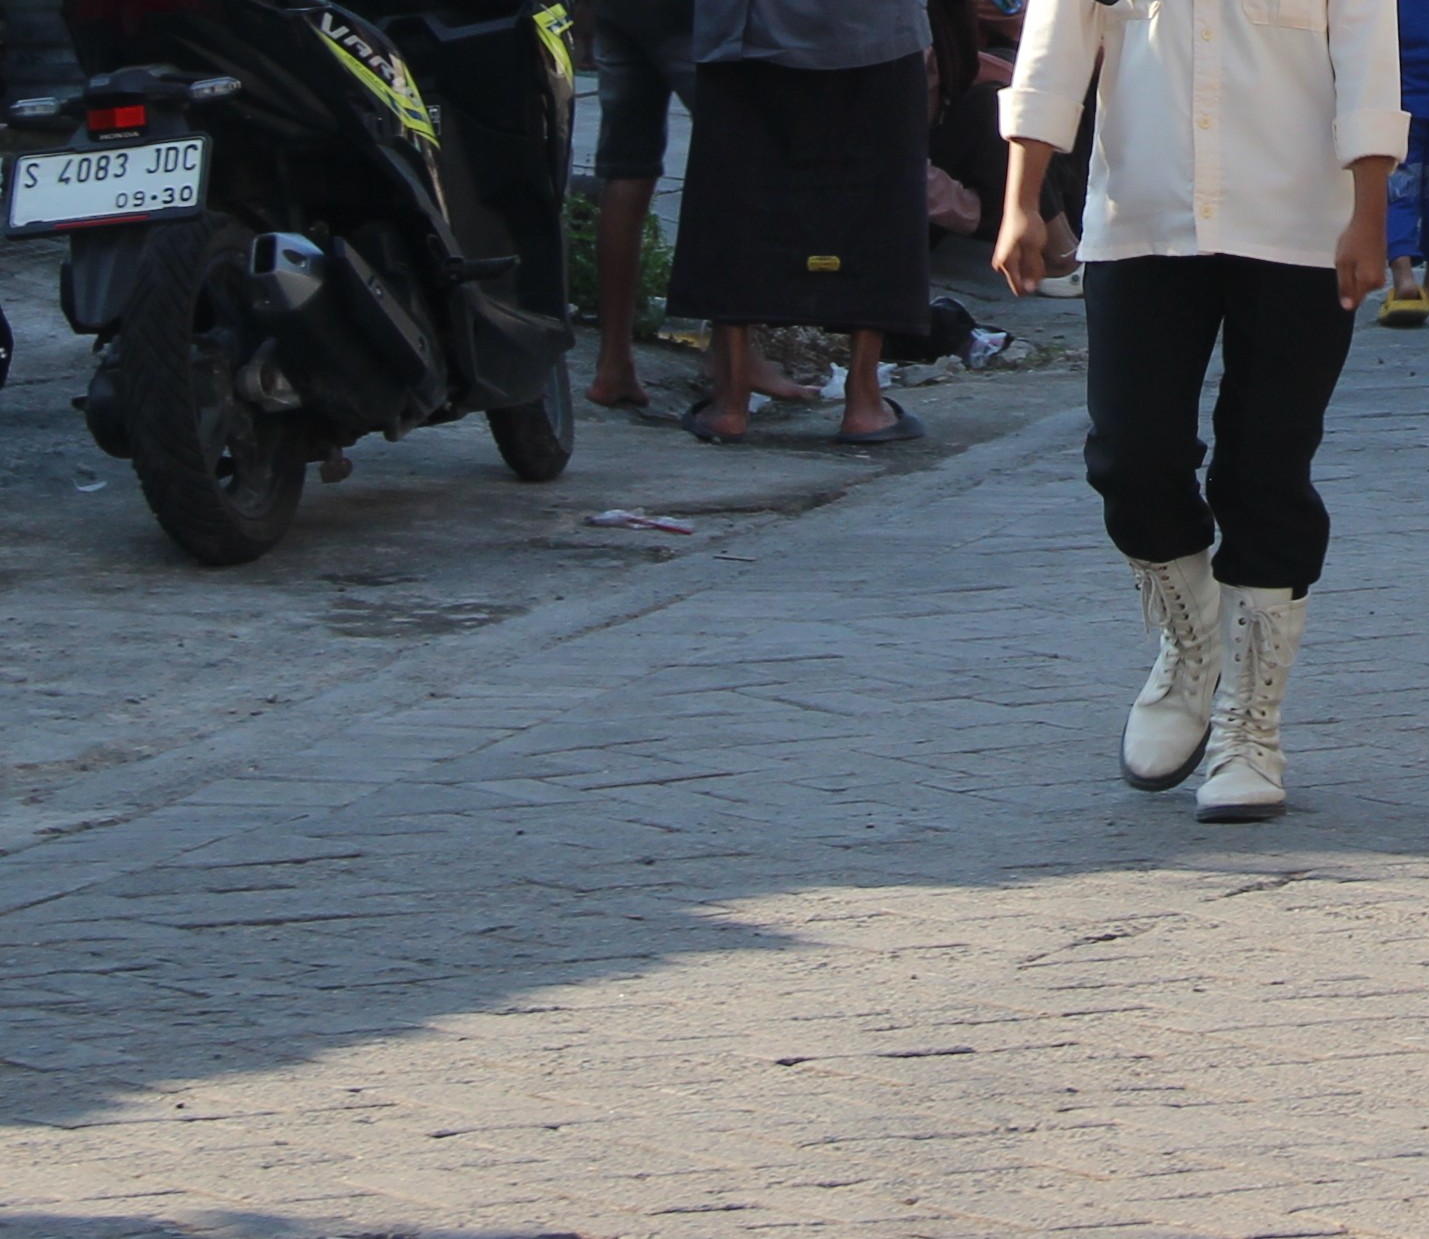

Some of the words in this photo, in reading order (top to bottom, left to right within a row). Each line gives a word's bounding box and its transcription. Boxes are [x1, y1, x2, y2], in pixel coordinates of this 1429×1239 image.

[24, 163, 40, 189] S
[57, 153, 130, 185] 4083
[145, 144, 199, 175] JDC
